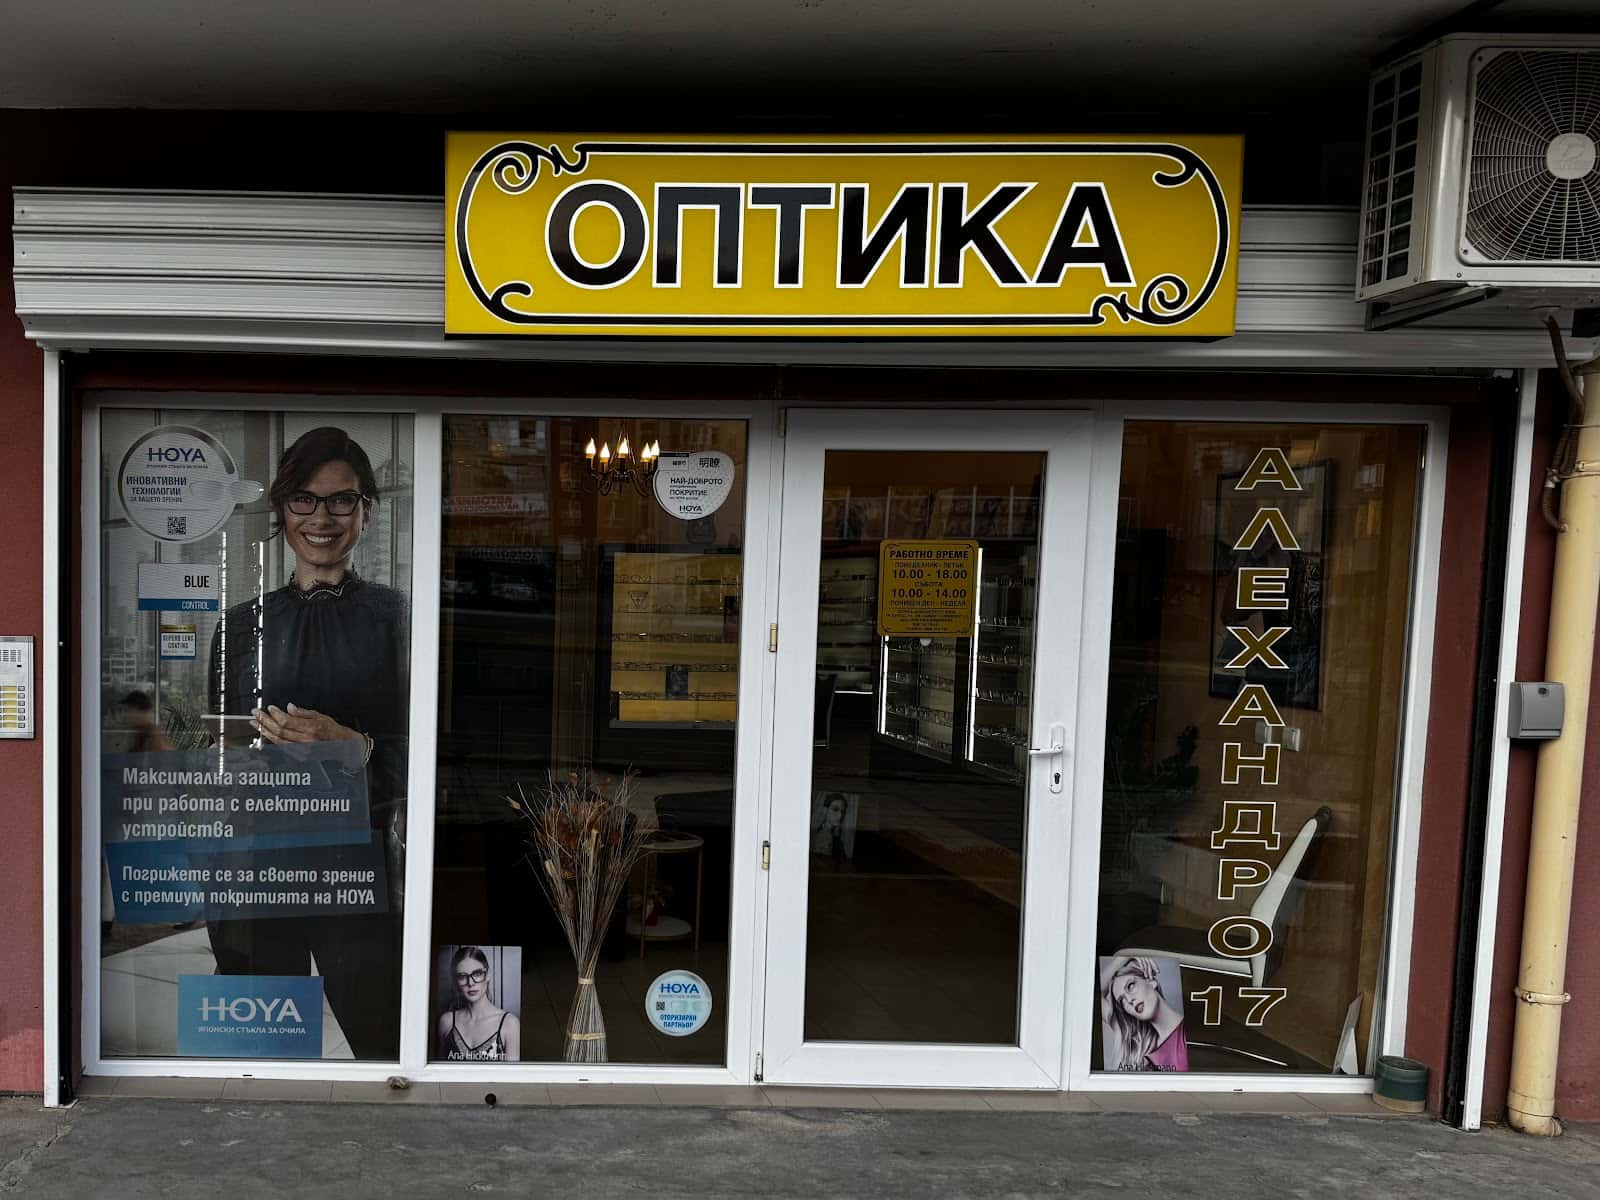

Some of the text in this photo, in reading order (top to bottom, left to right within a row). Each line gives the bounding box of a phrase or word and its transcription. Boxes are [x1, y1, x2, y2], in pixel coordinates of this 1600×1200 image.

[544, 179, 1136, 290] ОПТИКА
[146, 447, 206, 462] HOYA
[126, 476, 187, 486] ИНОВАТИВНИ
[670, 476, 723, 485] НАЙ-ДОБРОТО
[131, 487, 181, 496] ТЕХНОЛОГИИ
[889, 550, 969, 559] РАБОТНО ВРЕМЕ
[894, 569, 924, 579] 10.00
[936, 569, 967, 579] 18.00
[184, 575, 210, 588] BLUE
[892, 588, 923, 599] 10.00
[936, 588, 967, 599] 14.00
[181, 600, 210, 610] CONTROL
[1208, 447, 1303, 959] АЛЕХАНДРО
[122, 767, 311, 788] Максимална защита
[122, 794, 350, 815] при работа с електронни
[122, 821, 234, 841] устройства
[122, 865, 375, 886] Погрижете се за своето зрение
[121, 889, 375, 908] с премиум покритията на HOYA
[660, 983, 700, 993] HOYA
[197, 996, 303, 1023] HOYA
[1190, 985, 1288, 1026] 17
[236, 1026, 266, 1034] СТЪКЛА
[267, 1026, 278, 1034] ЗА
[447, 1049, 465, 1060] Ana
[1117, 1061, 1134, 1072] Ana
